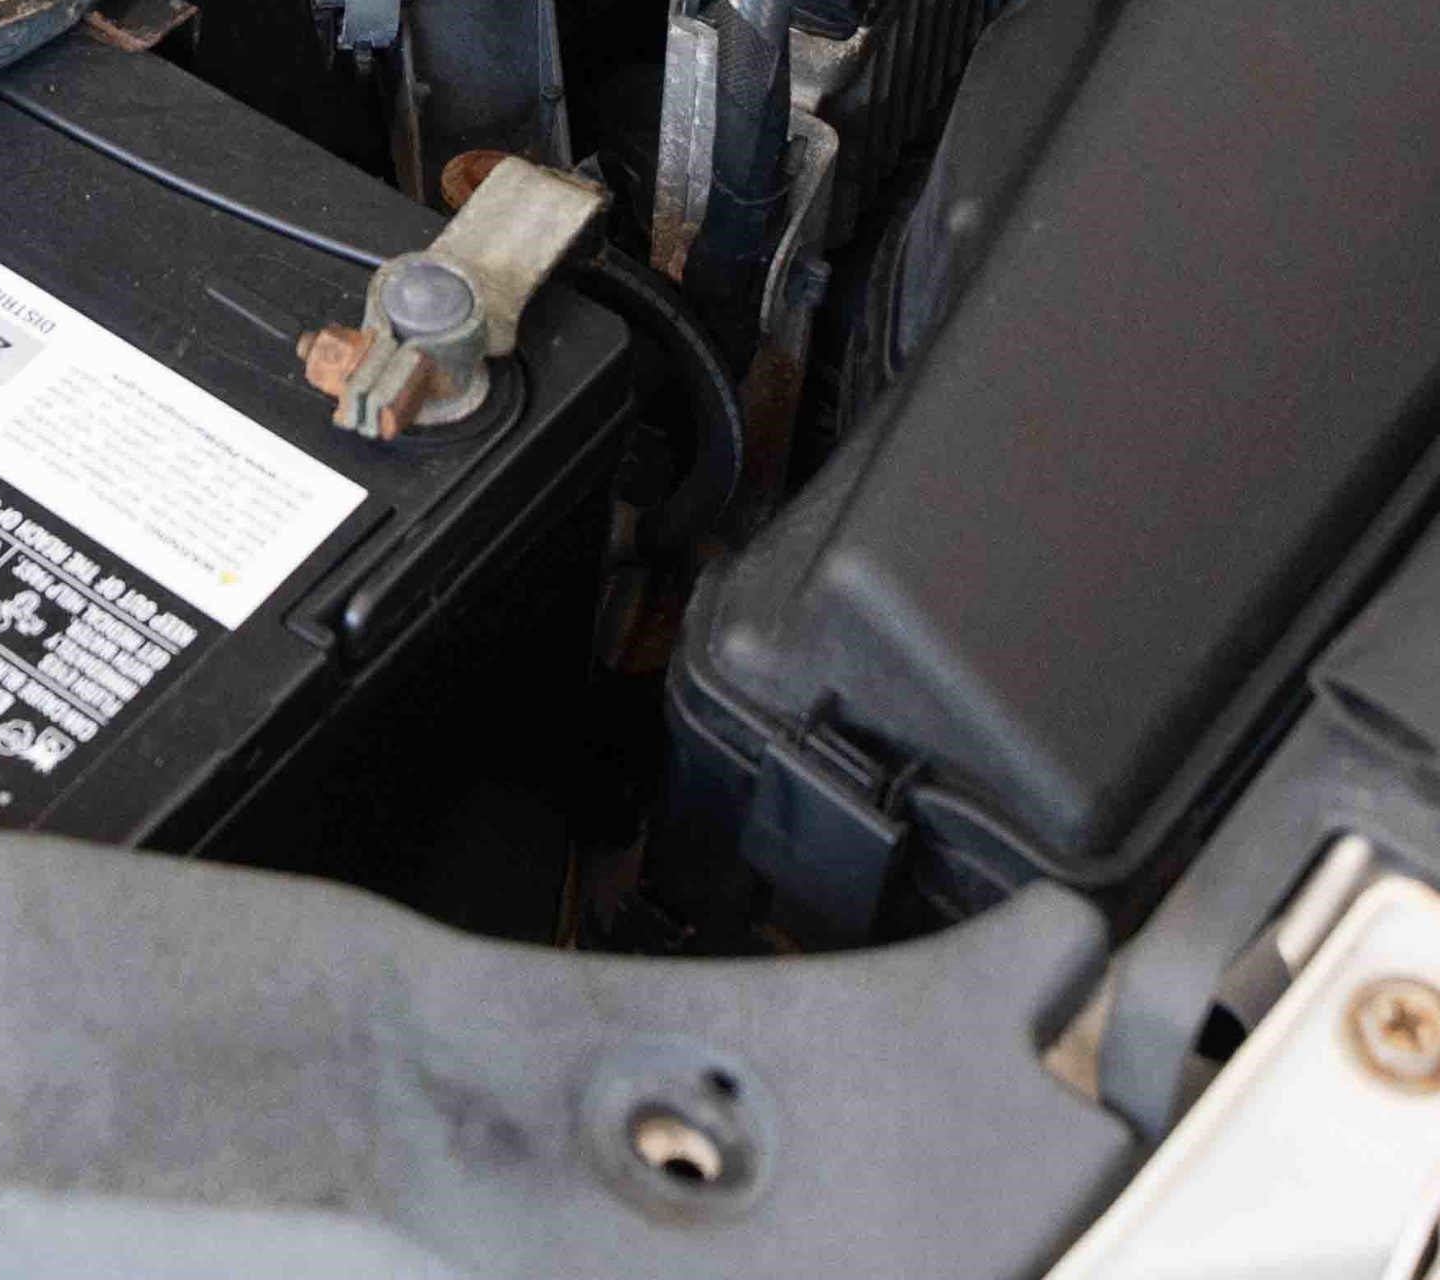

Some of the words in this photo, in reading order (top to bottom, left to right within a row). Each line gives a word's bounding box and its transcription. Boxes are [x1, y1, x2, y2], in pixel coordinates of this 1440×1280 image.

[13, 519, 72, 564] REACH
[61, 551, 100, 585] THE
[93, 574, 125, 600] OF
[115, 588, 157, 622] OUT
[148, 611, 197, 648] KEEP
